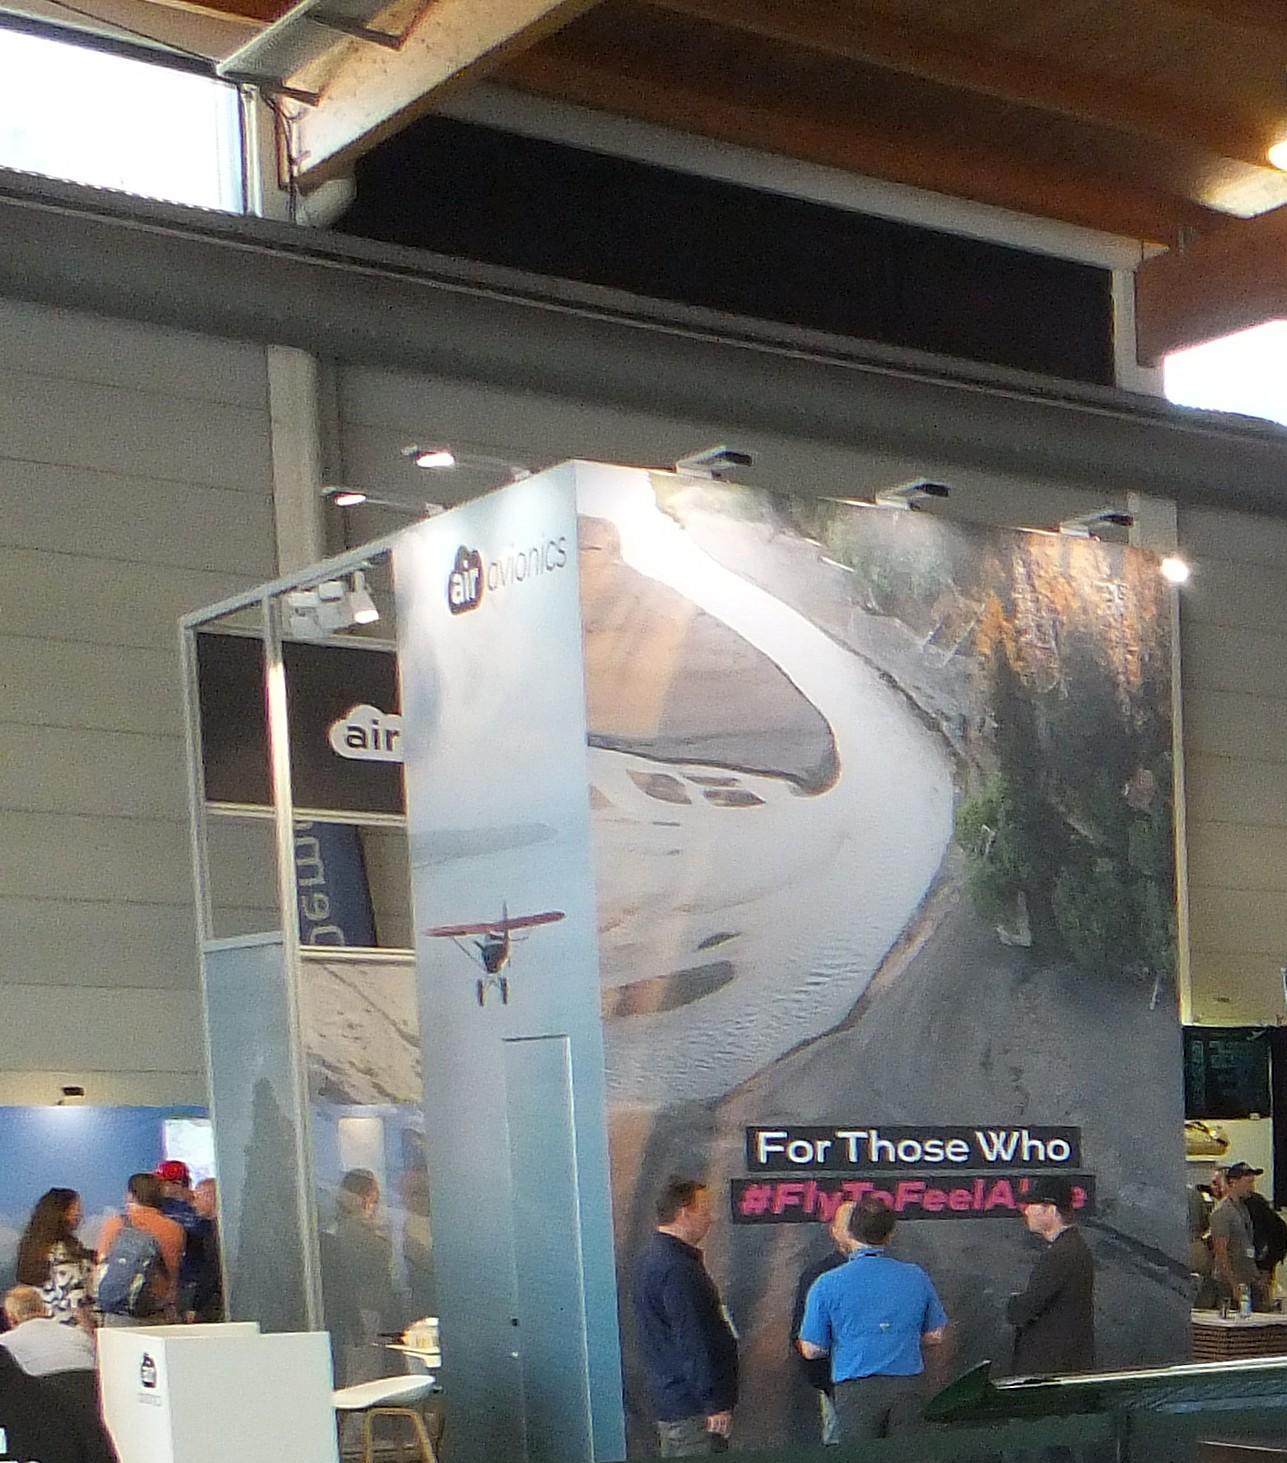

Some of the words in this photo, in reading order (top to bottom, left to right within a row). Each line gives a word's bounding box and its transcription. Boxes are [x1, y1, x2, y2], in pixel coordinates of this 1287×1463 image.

[488, 537, 567, 591] avionics
[346, 719, 400, 751] air
[758, 1131, 831, 1164] For
[836, 1129, 970, 1163] Those
[975, 1129, 1071, 1162] Who
[740, 1178, 1088, 1222] #FlyTFeelAle
